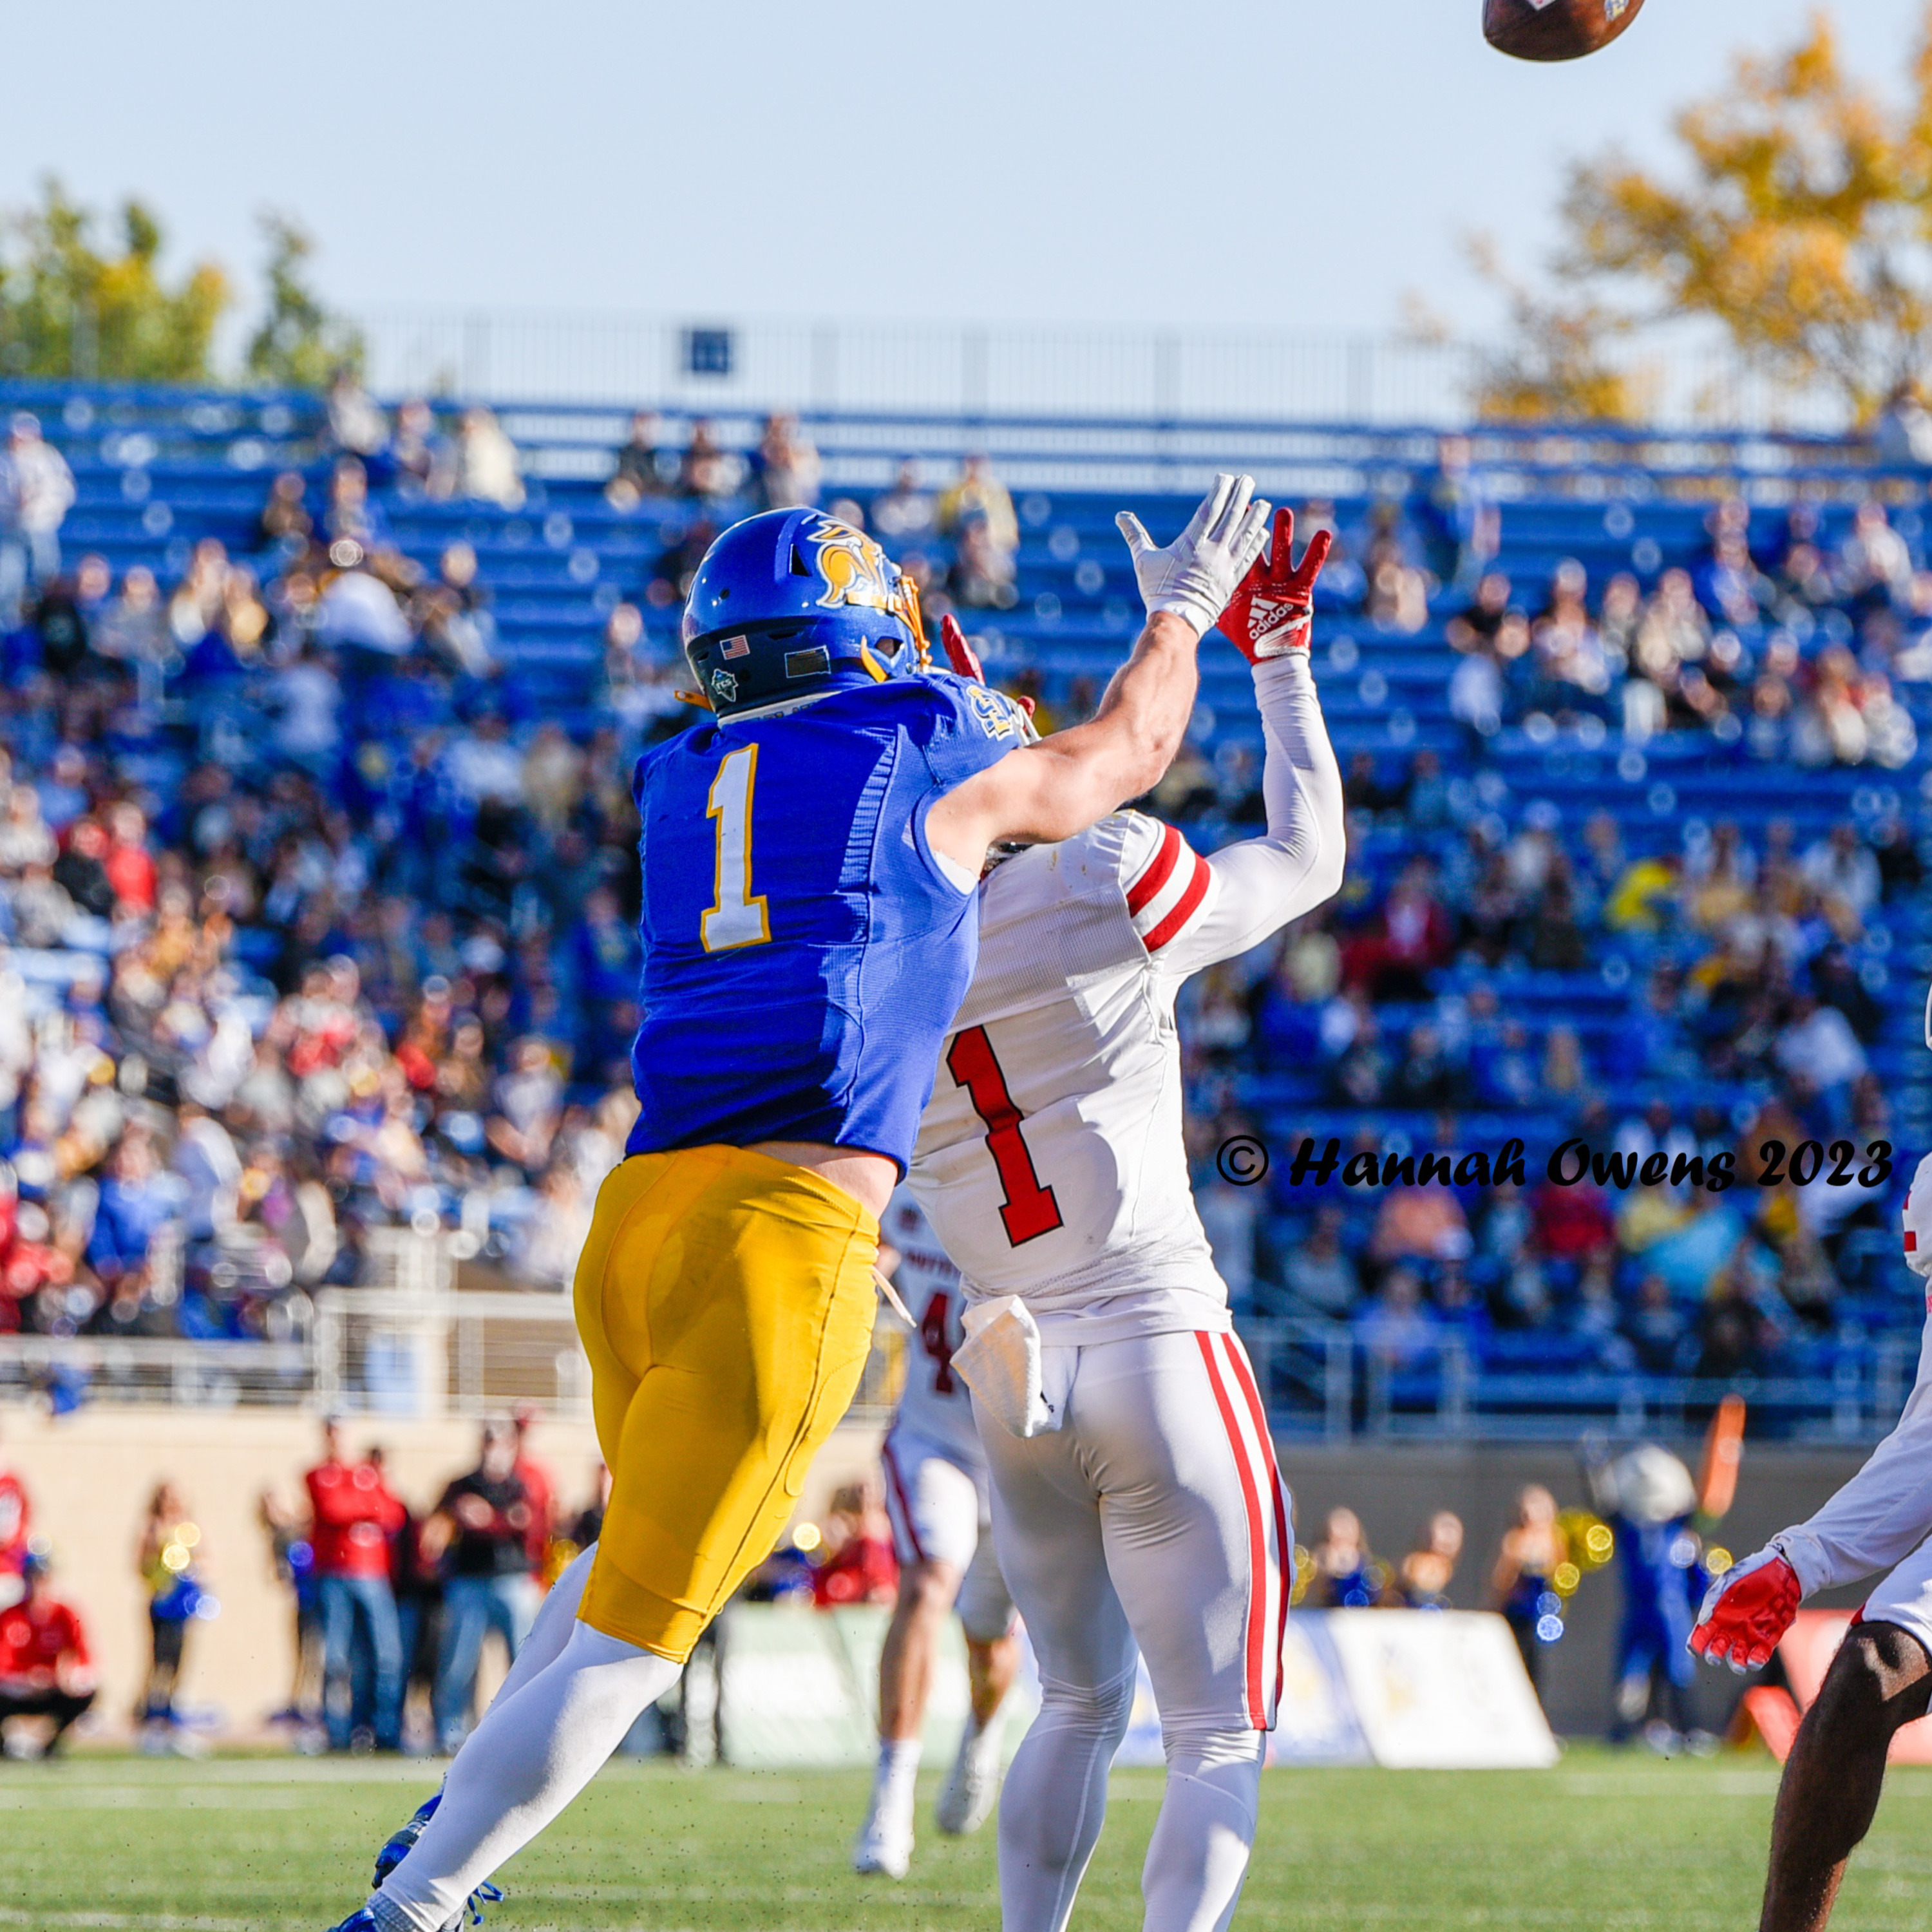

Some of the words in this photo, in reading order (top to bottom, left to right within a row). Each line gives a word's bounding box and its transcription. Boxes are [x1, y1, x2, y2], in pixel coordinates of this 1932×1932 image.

[1249, 603, 1294, 640] adidas
[700, 743, 772, 952] 1
[946, 1024, 1064, 1248] 1
[922, 1292, 954, 1394] 4
